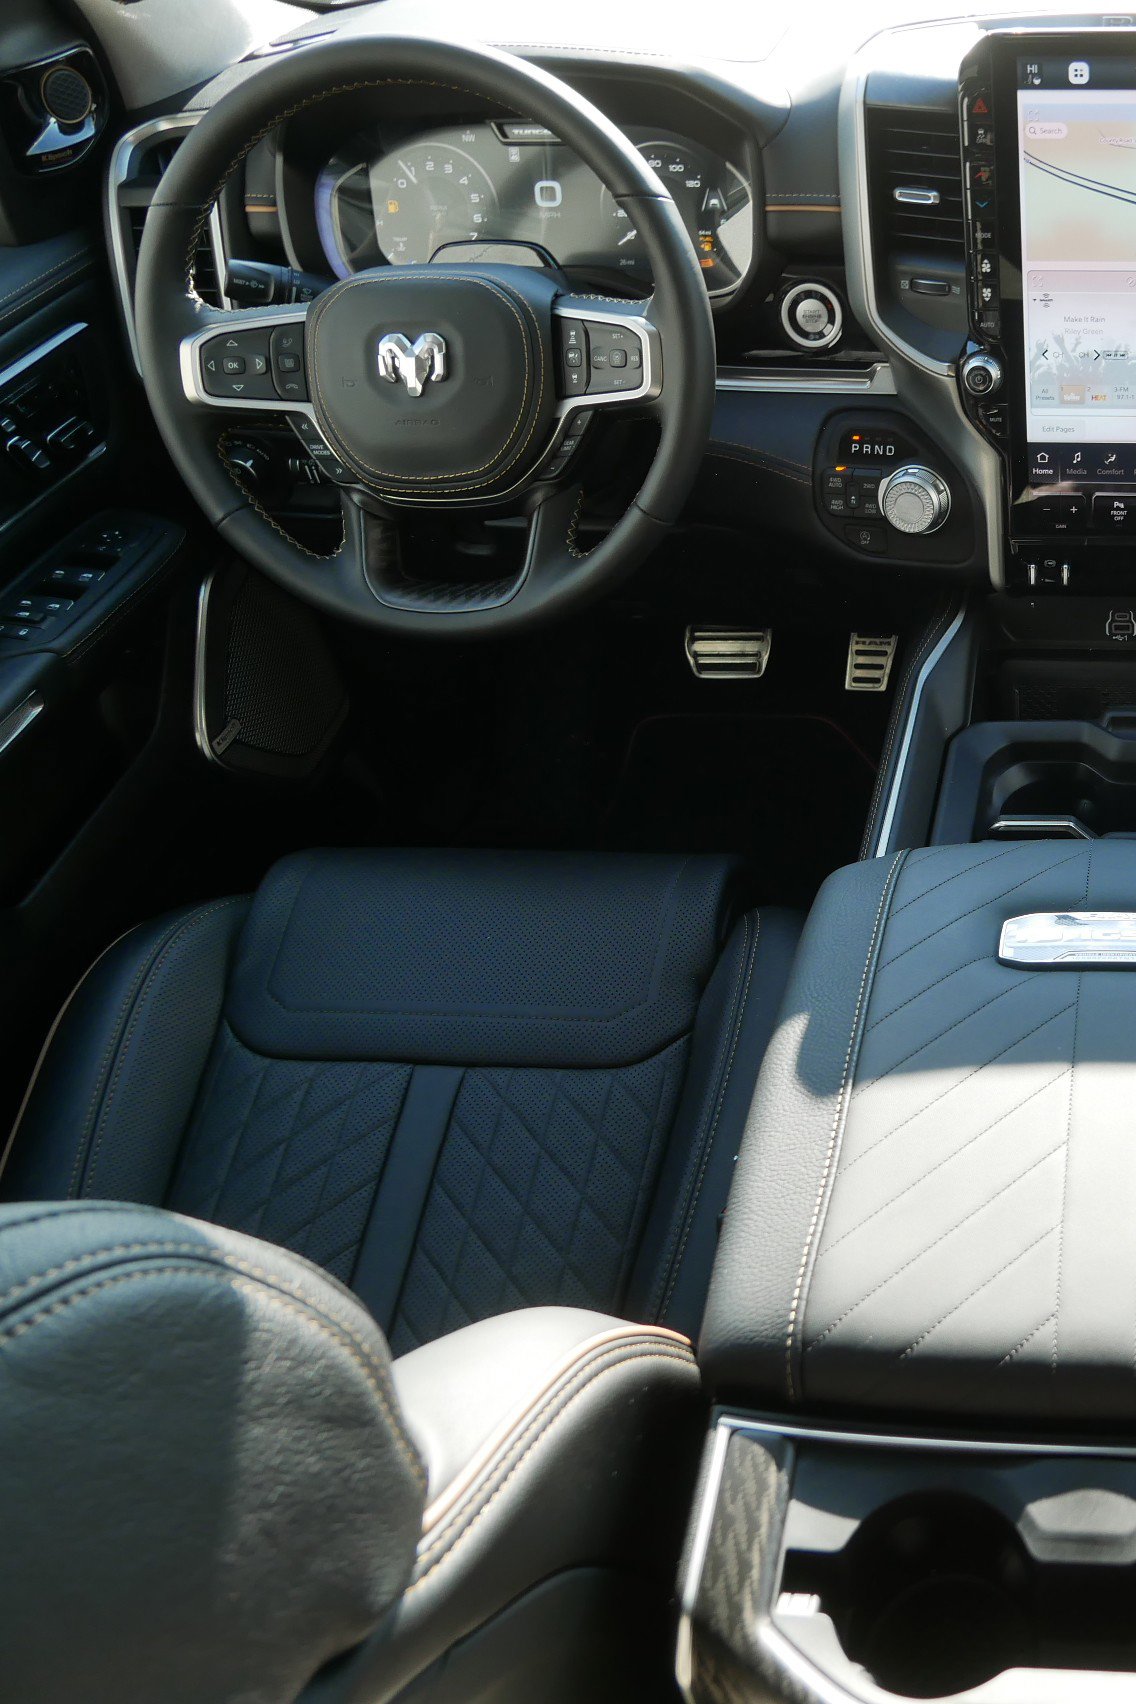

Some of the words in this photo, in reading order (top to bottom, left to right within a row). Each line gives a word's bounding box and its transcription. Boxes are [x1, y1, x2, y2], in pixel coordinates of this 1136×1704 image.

[1027, 64, 1038, 74] HI
[1040, 126, 1063, 135] Search
[425, 161, 434, 171] 2
[444, 164, 453, 174] 3
[398, 179, 407, 188] 0
[459, 176, 469, 185] 4
[686, 180, 701, 188] 120
[470, 193, 480, 203] 5
[534, 181, 562, 208] 0
[473, 213, 482, 223] 6
[469, 232, 478, 241] 7
[1055, 426, 1075, 434] Pages
[851, 443, 860, 454] P
[863, 444, 871, 454] R
[874, 445, 883, 455] N
[886, 445, 895, 456] D
